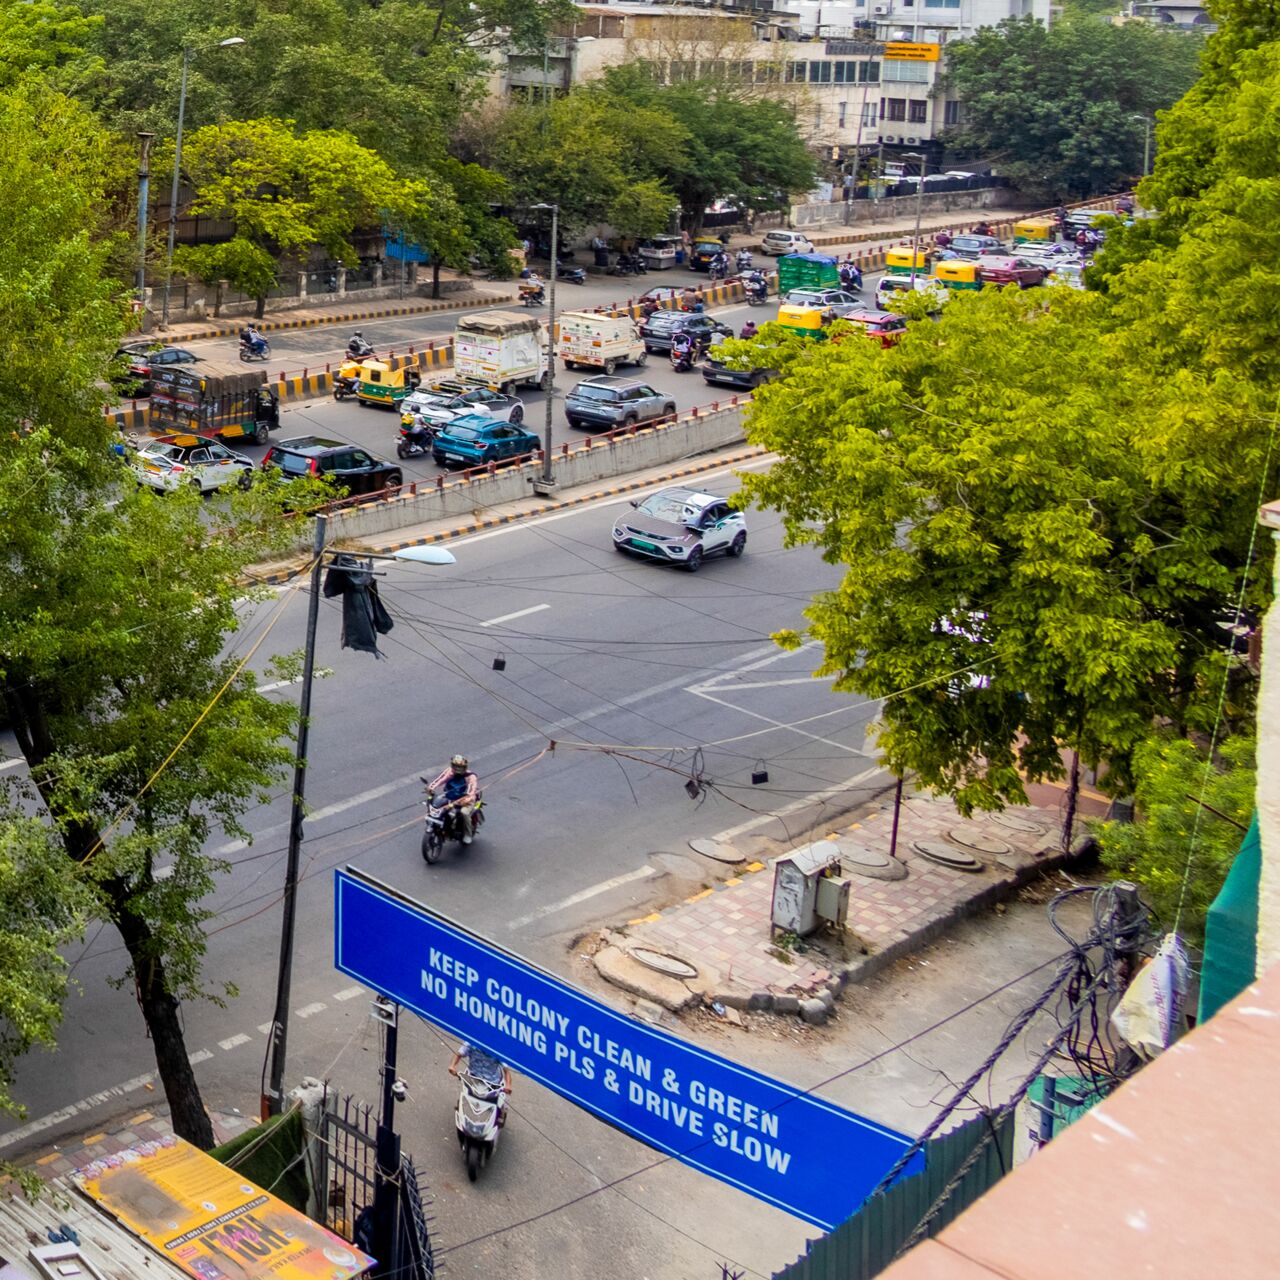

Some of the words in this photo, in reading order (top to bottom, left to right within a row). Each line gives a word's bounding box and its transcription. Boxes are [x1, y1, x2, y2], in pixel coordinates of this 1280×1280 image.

[421, 969, 447, 1000] NO
[455, 987, 547, 1056] HONKING
[555, 1041, 595, 1081] PLS
[603, 1068, 620, 1095] &
[629, 1080, 704, 1137] DRIVE
[713, 1122, 791, 1176] SLOW
[429, 947, 480, 987] KEEP
[486, 978, 570, 1038] COLONY
[577, 1025, 651, 1081] CLEAN
[662, 1068, 681, 1095] &
[689, 1080, 779, 1138] GREEN
[199, 1213, 290, 1271] HOLI
